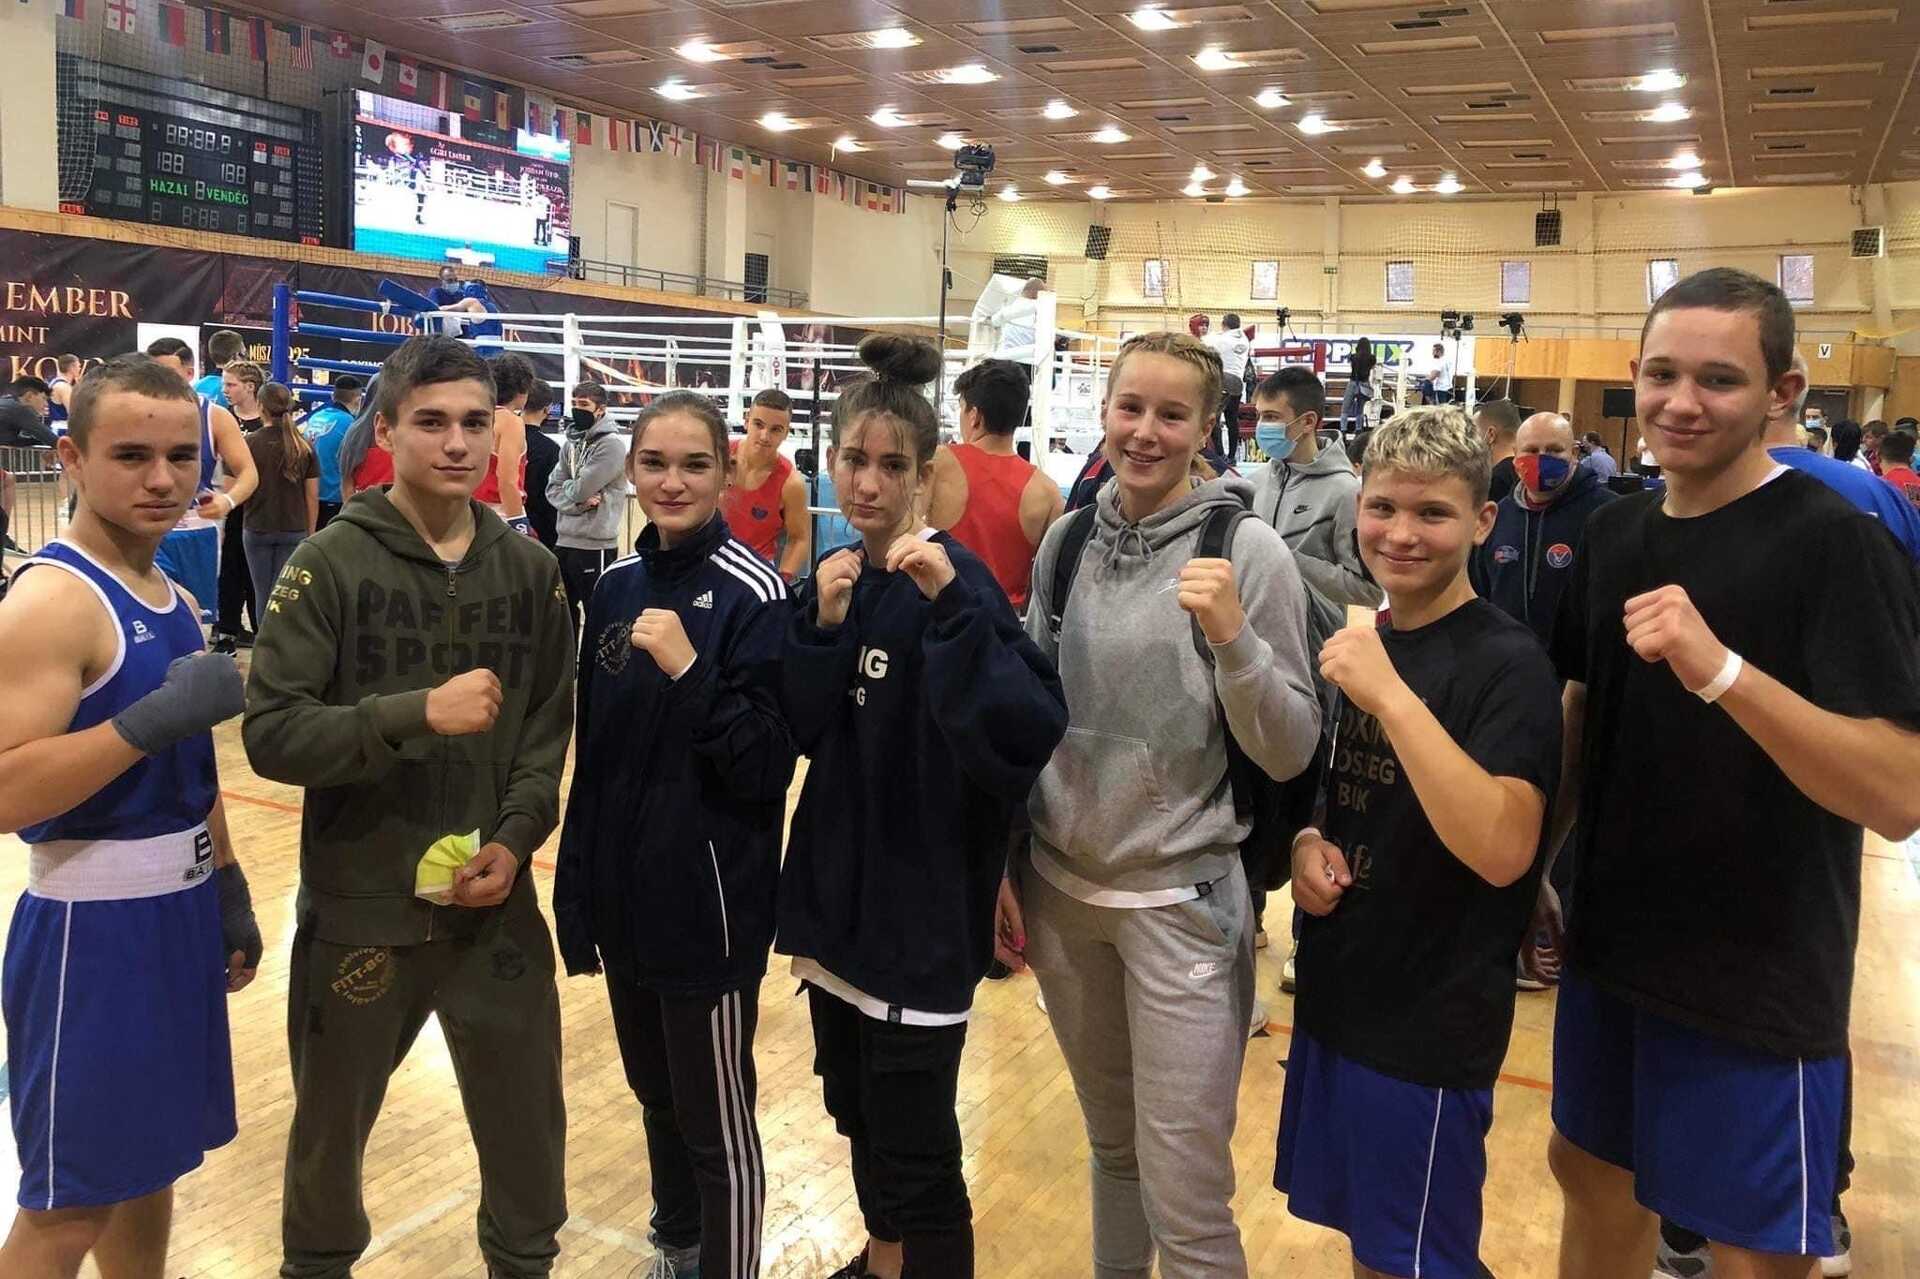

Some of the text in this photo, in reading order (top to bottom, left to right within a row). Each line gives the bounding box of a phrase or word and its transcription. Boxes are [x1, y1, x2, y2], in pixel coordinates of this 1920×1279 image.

[150, 179, 188, 196] HAZAI
[6, 281, 134, 319] EMBER
[0, 325, 49, 344] INT
[1819, 344, 1830, 357] V
[281, 564, 313, 585] ING
[271, 584, 300, 601] ZEG
[195, 830, 213, 865] B
